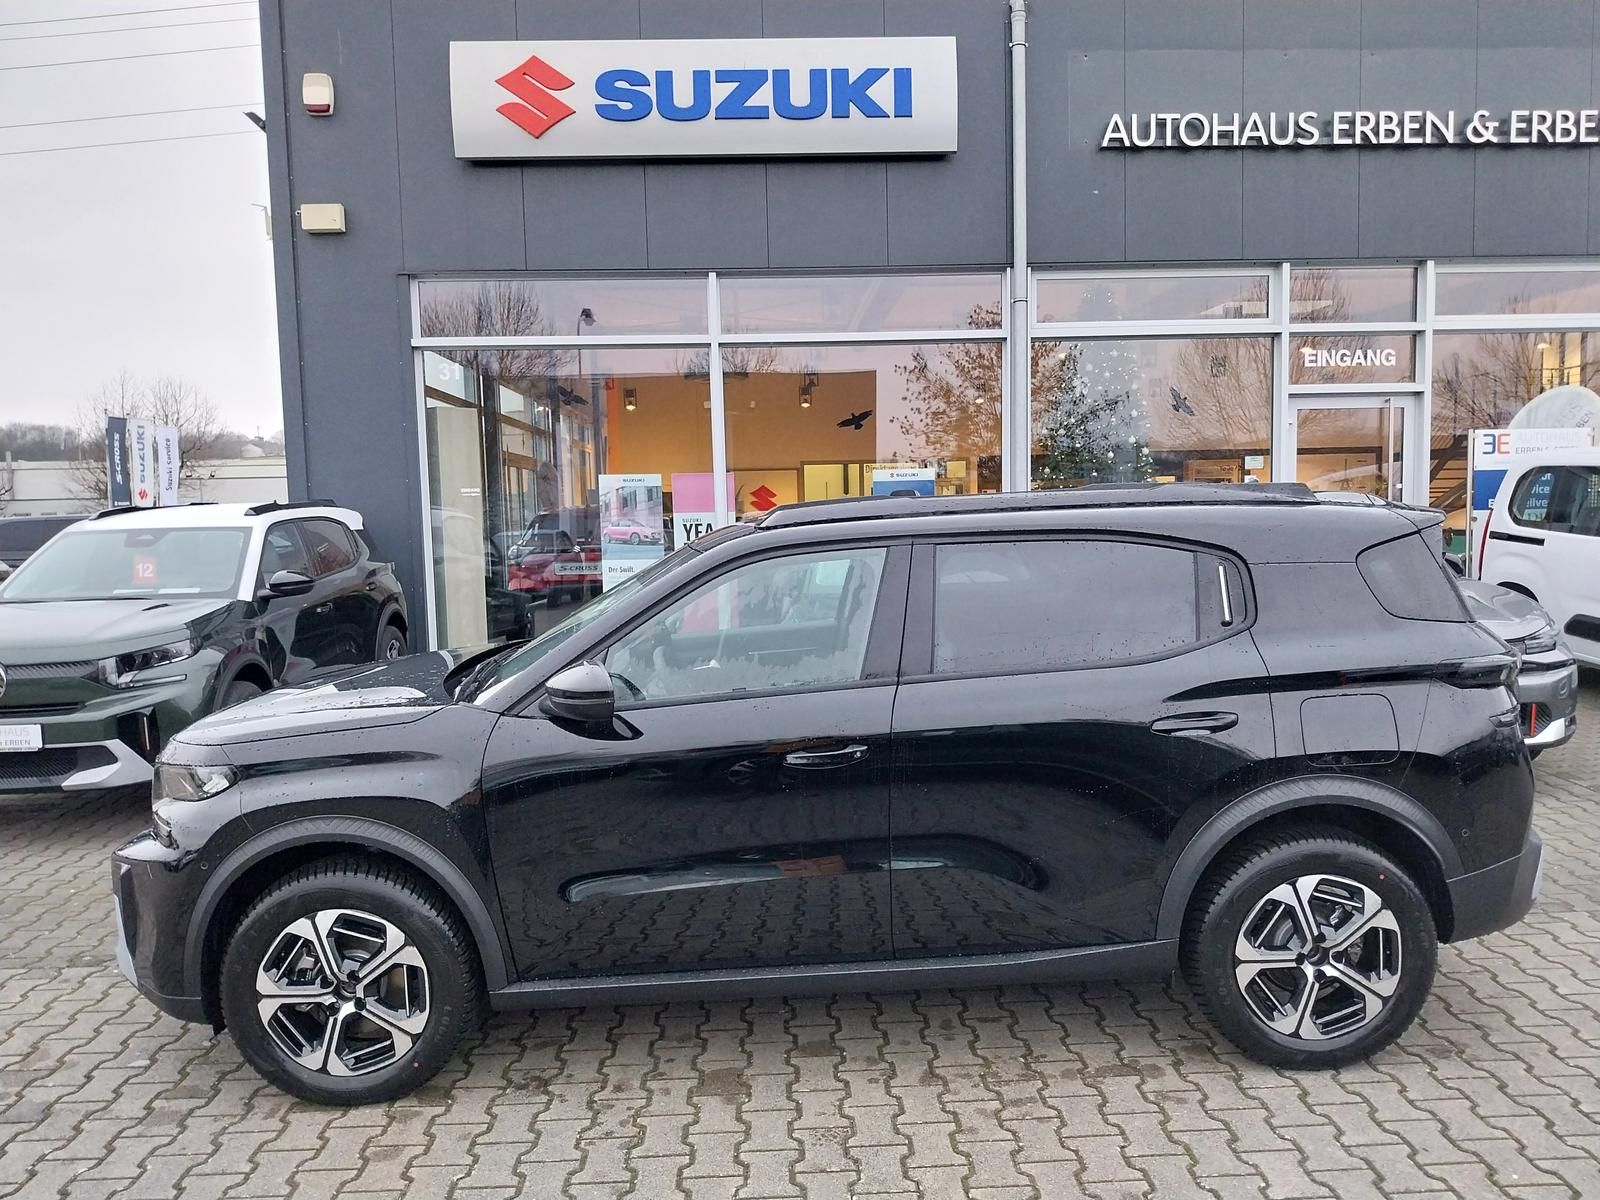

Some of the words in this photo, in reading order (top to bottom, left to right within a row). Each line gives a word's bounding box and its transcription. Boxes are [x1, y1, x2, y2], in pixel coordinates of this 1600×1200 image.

[594, 67, 913, 121] SUZUKI
[1102, 111, 1320, 147] AUTOHAUS
[1332, 111, 1455, 145] ERBEN
[1466, 110, 1499, 144] &
[1510, 109, 1600, 143] ERBE
[440, 363, 460, 380] 31
[1304, 349, 1397, 367] EINGANG
[137, 425, 146, 484] SUZUKI
[135, 563, 154, 577] 12
